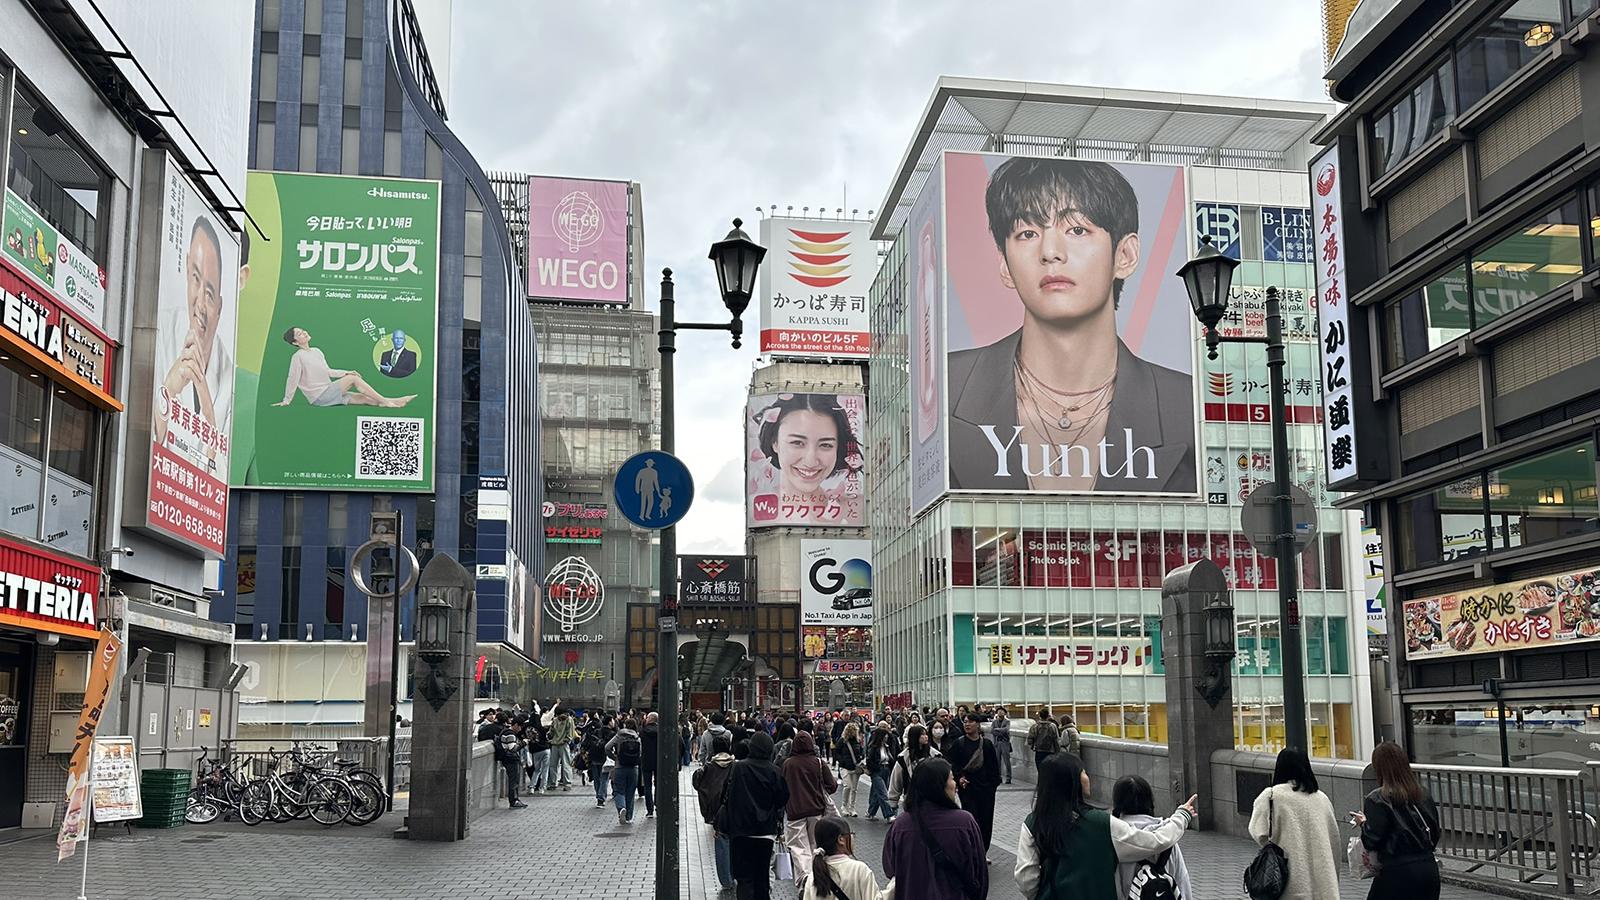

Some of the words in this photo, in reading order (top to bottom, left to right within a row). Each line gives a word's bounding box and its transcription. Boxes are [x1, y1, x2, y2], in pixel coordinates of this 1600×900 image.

[297, 240, 418, 275] サロンパス
[1320, 204, 1341, 307] 本場の味
[69, 254, 98, 288] MASSAGE
[538, 257, 618, 290] WEGO
[325, 291, 351, 299] Salonpas
[773, 292, 866, 313] かっぱ寿司
[789, 315, 820, 325] KAPPA
[822, 317, 849, 326] SUSHI
[1245, 311, 1264, 319] kobe
[0, 286, 64, 364] ERIA
[1246, 318, 1264, 327] beef
[779, 332, 859, 344] 向かいのビル5F
[766, 342, 789, 350] Across
[1254, 406, 1265, 421] 5
[171, 399, 229, 456] 東京美容外科
[978, 425, 1158, 479] Yunth
[153, 452, 213, 499] 大阪駅前第1ビル
[215, 487, 226, 506] 2F
[1210, 494, 1225, 503] 4F
[11, 504, 35, 515] ZETTERIA
[543, 505, 553, 514] 7F
[782, 505, 840, 519] ワクワク
[158, 500, 223, 546] 0120-658-958
[47, 530, 69, 542] ZETTERIA
[546, 526, 602, 538] サイゼリヤ
[1029, 540, 1066, 551] Scenic
[1070, 541, 1101, 552] Place
[1104, 539, 1137, 561] 3F
[1058, 556, 1080, 567] Spot
[686, 581, 740, 594] 心斎橋筋
[1460, 592, 1515, 622] 焼かに
[1483, 615, 1552, 645] かにすき
[992, 645, 1012, 664] 薬
[1018, 645, 1130, 666] サンドラッグ
[0, 705, 18, 714] OFFEE
